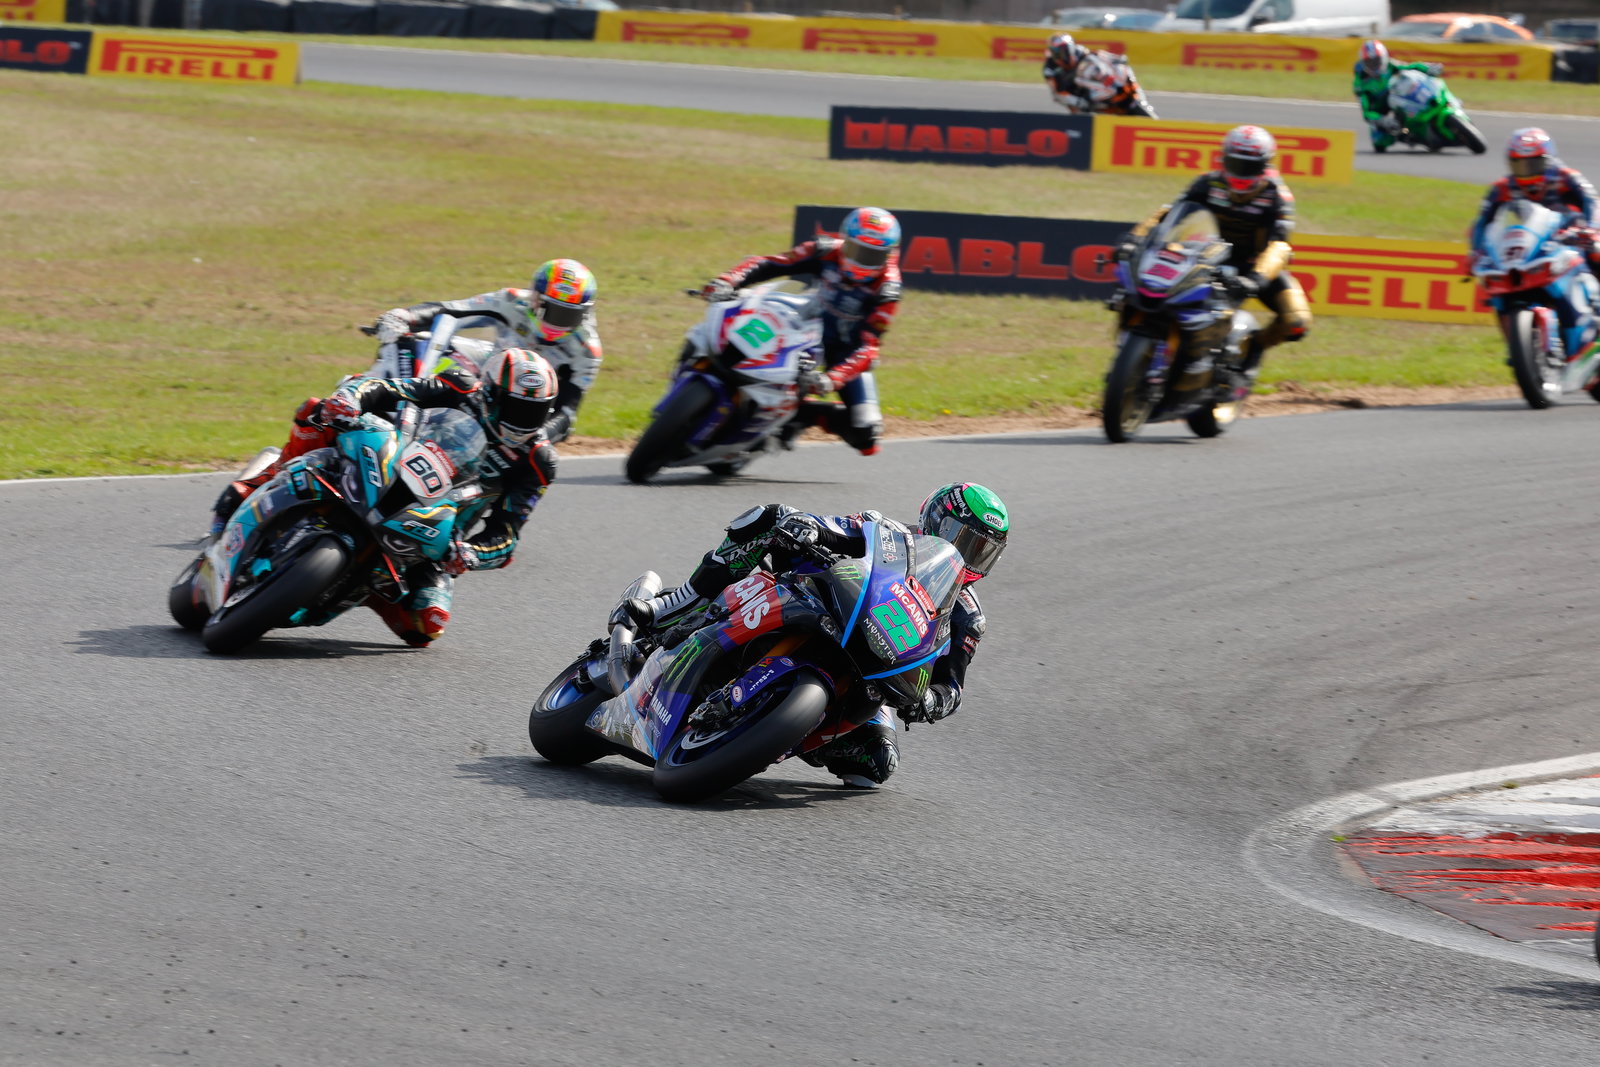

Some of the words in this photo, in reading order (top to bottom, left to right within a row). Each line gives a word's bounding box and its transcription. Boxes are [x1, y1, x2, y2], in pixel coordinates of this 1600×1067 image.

[0, 39, 71, 65] LO
[100, 39, 279, 80] PIRELLI
[844, 115, 1070, 158] DIABLO
[405, 454, 443, 494] 60
[985, 514, 1003, 528] SHOEI
[870, 599, 921, 654] 22
[891, 583, 929, 636] McAMS
[864, 618, 897, 664] MONSTER
[650, 696, 672, 726] YAMAHA
